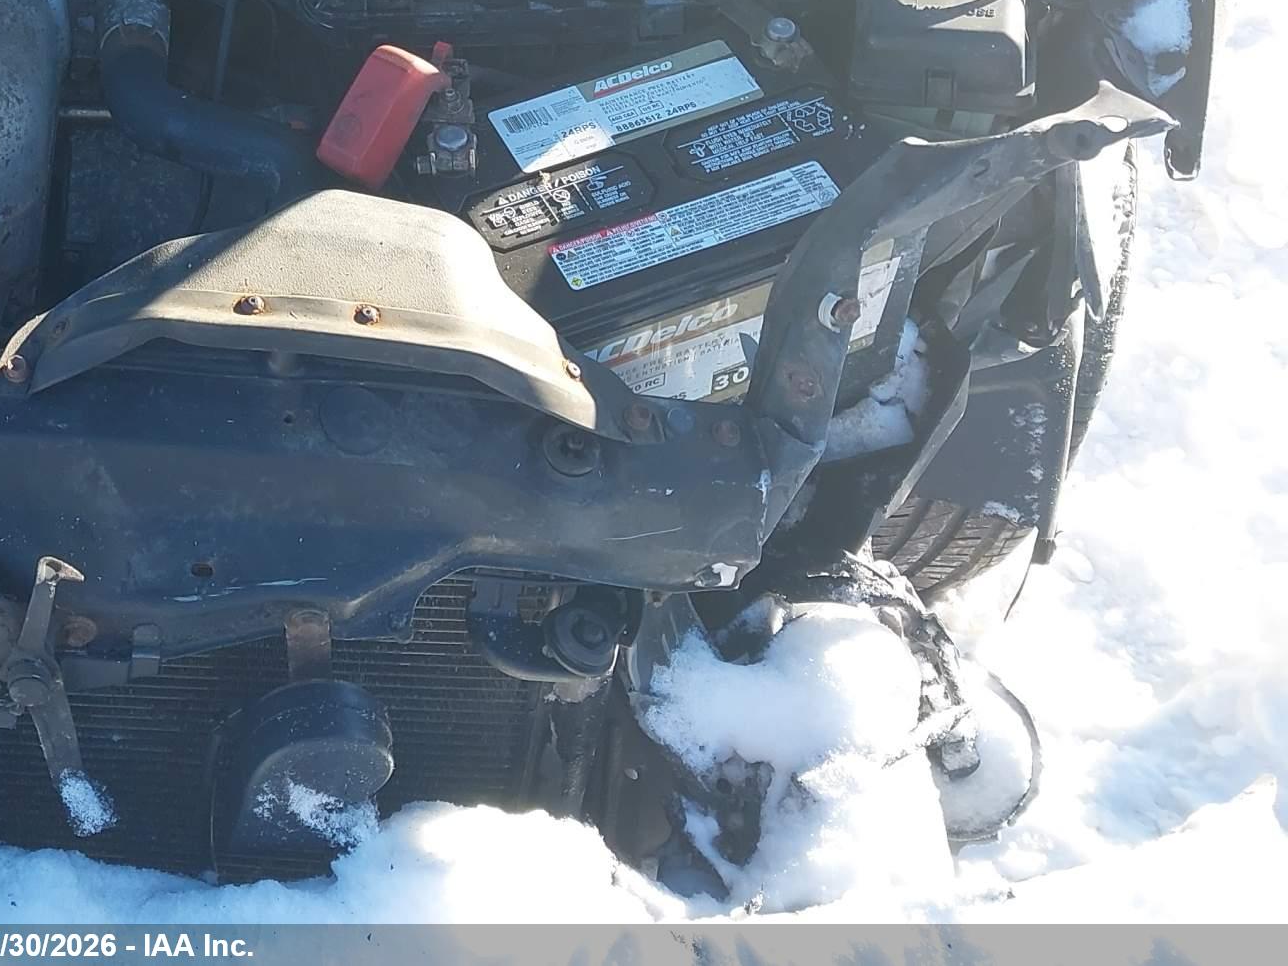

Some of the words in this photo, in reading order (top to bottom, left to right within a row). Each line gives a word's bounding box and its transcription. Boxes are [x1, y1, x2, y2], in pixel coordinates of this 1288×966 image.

[594, 60, 672, 93] ACDelco
[665, 100, 697, 116] 24RPS
[561, 121, 597, 140] 24RPS
[560, 165, 601, 184] POISON
[713, 365, 750, 391] 30
